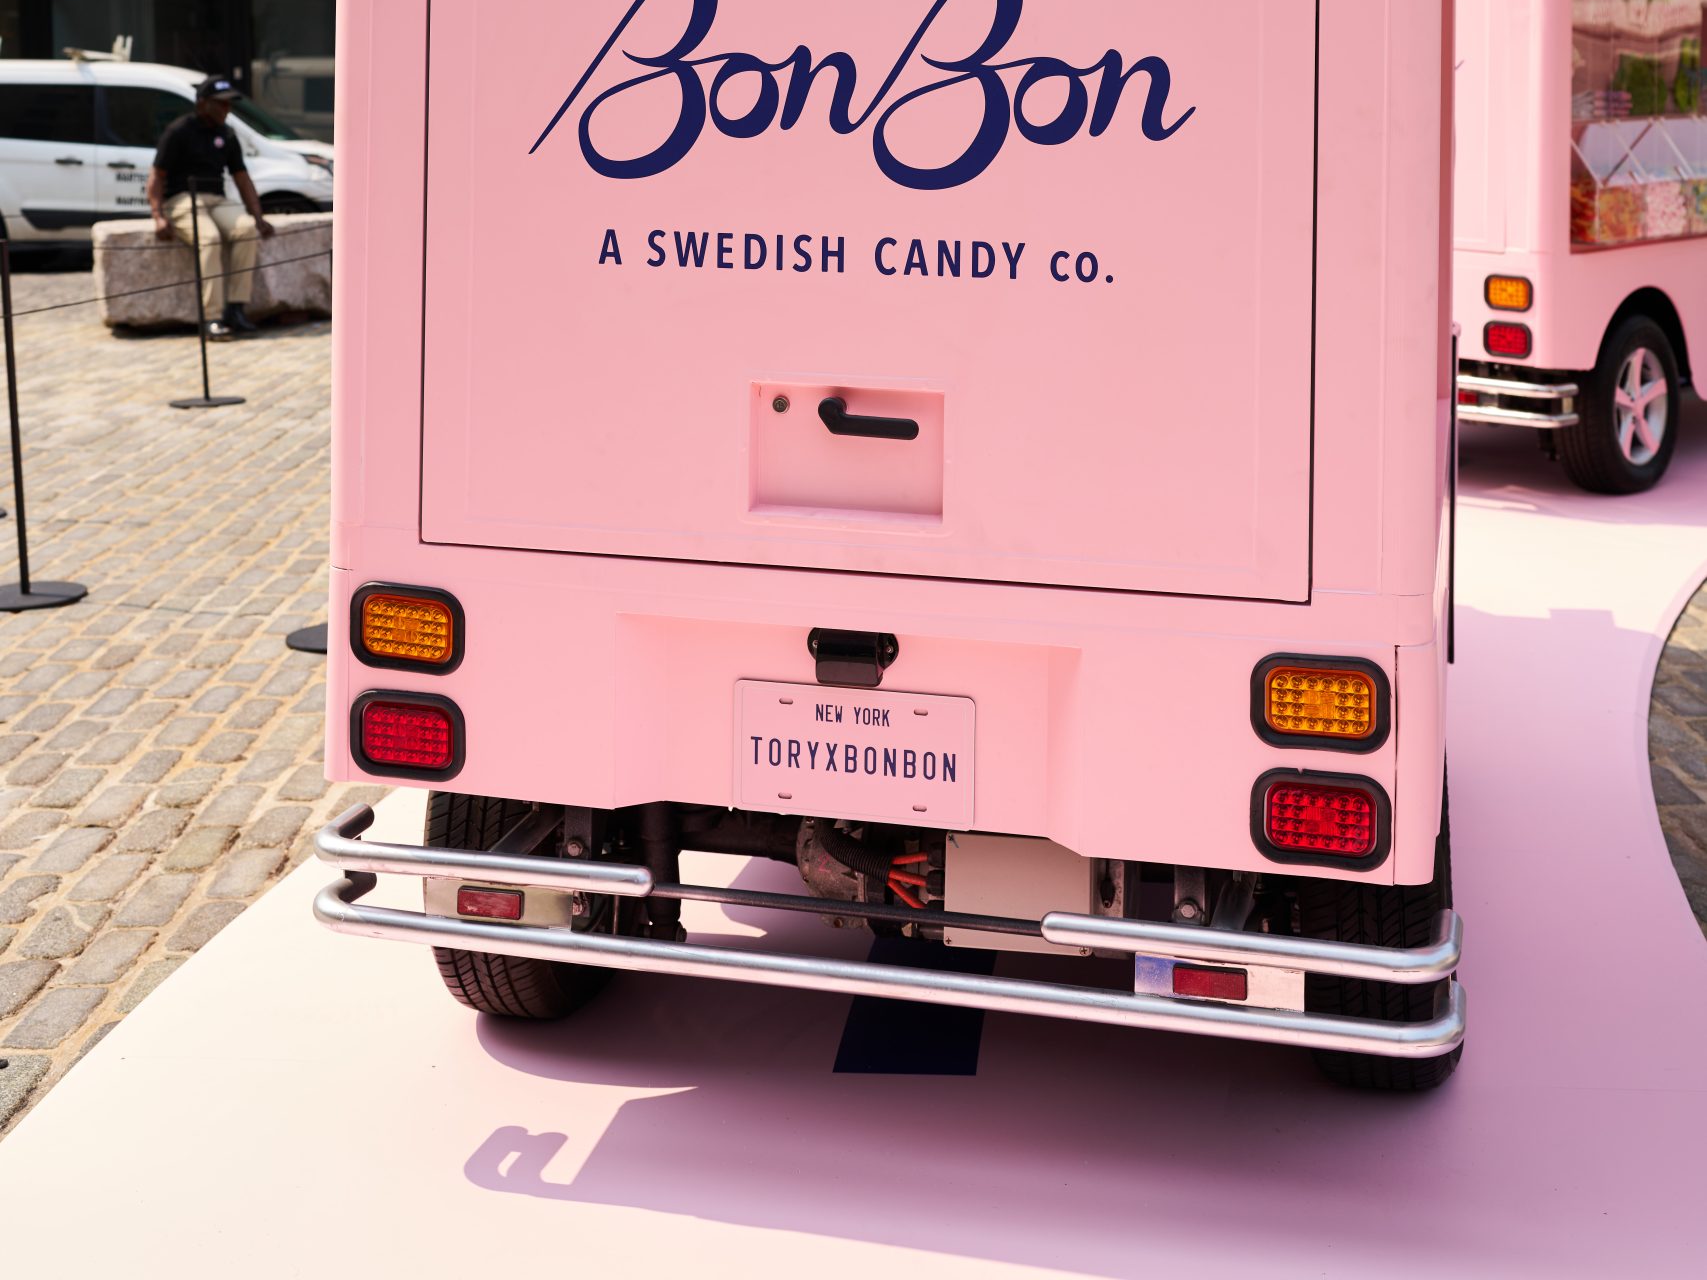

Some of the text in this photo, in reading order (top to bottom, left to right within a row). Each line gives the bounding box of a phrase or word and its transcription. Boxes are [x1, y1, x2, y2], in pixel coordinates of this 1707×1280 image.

[598, 228, 622, 265] A
[646, 229, 845, 273] SWEDISH
[874, 237, 1026, 280] CANDY
[815, 703, 890, 727] NEW YORK
[750, 736, 956, 783] TORYXBONBON
